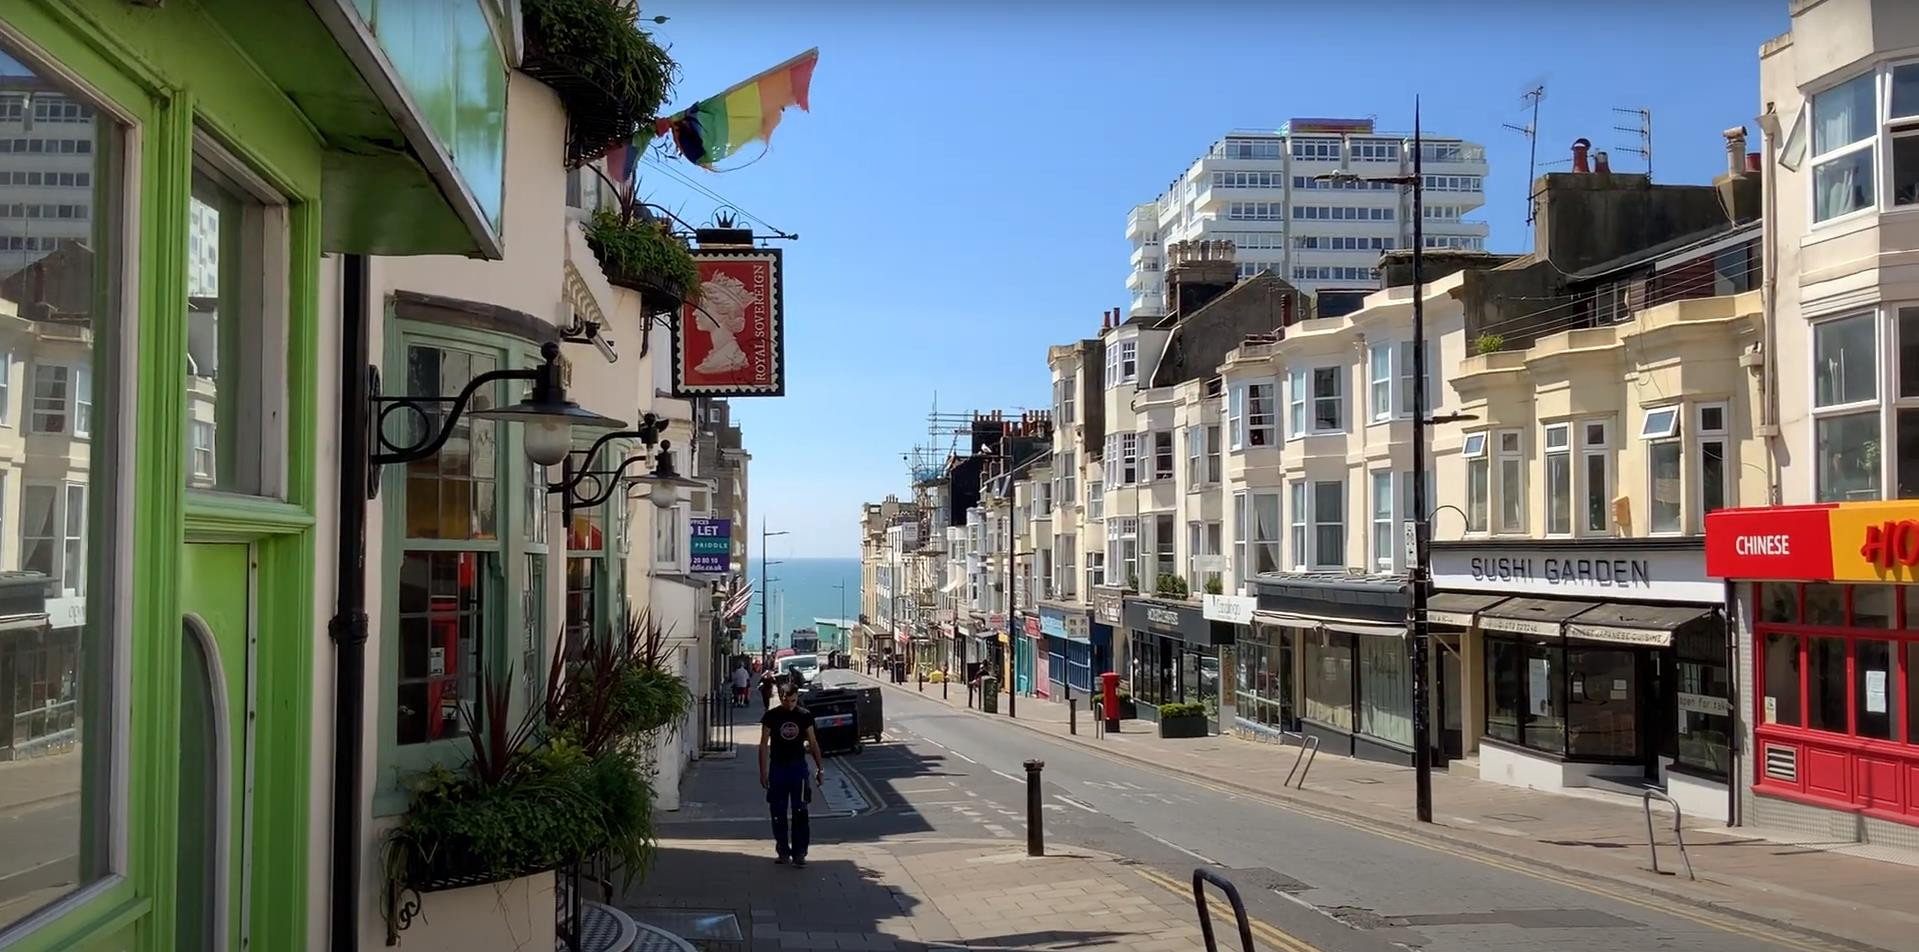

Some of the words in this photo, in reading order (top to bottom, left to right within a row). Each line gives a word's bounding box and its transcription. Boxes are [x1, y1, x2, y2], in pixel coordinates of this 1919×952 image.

[754, 265, 765, 338] SOVEREIGN
[755, 340, 766, 382] ROYAL
[697, 525, 719, 536] LET
[1735, 534, 1790, 556] CHINESE
[1471, 557, 1533, 580] SUSHI
[1544, 557, 1650, 586] GARDEN
